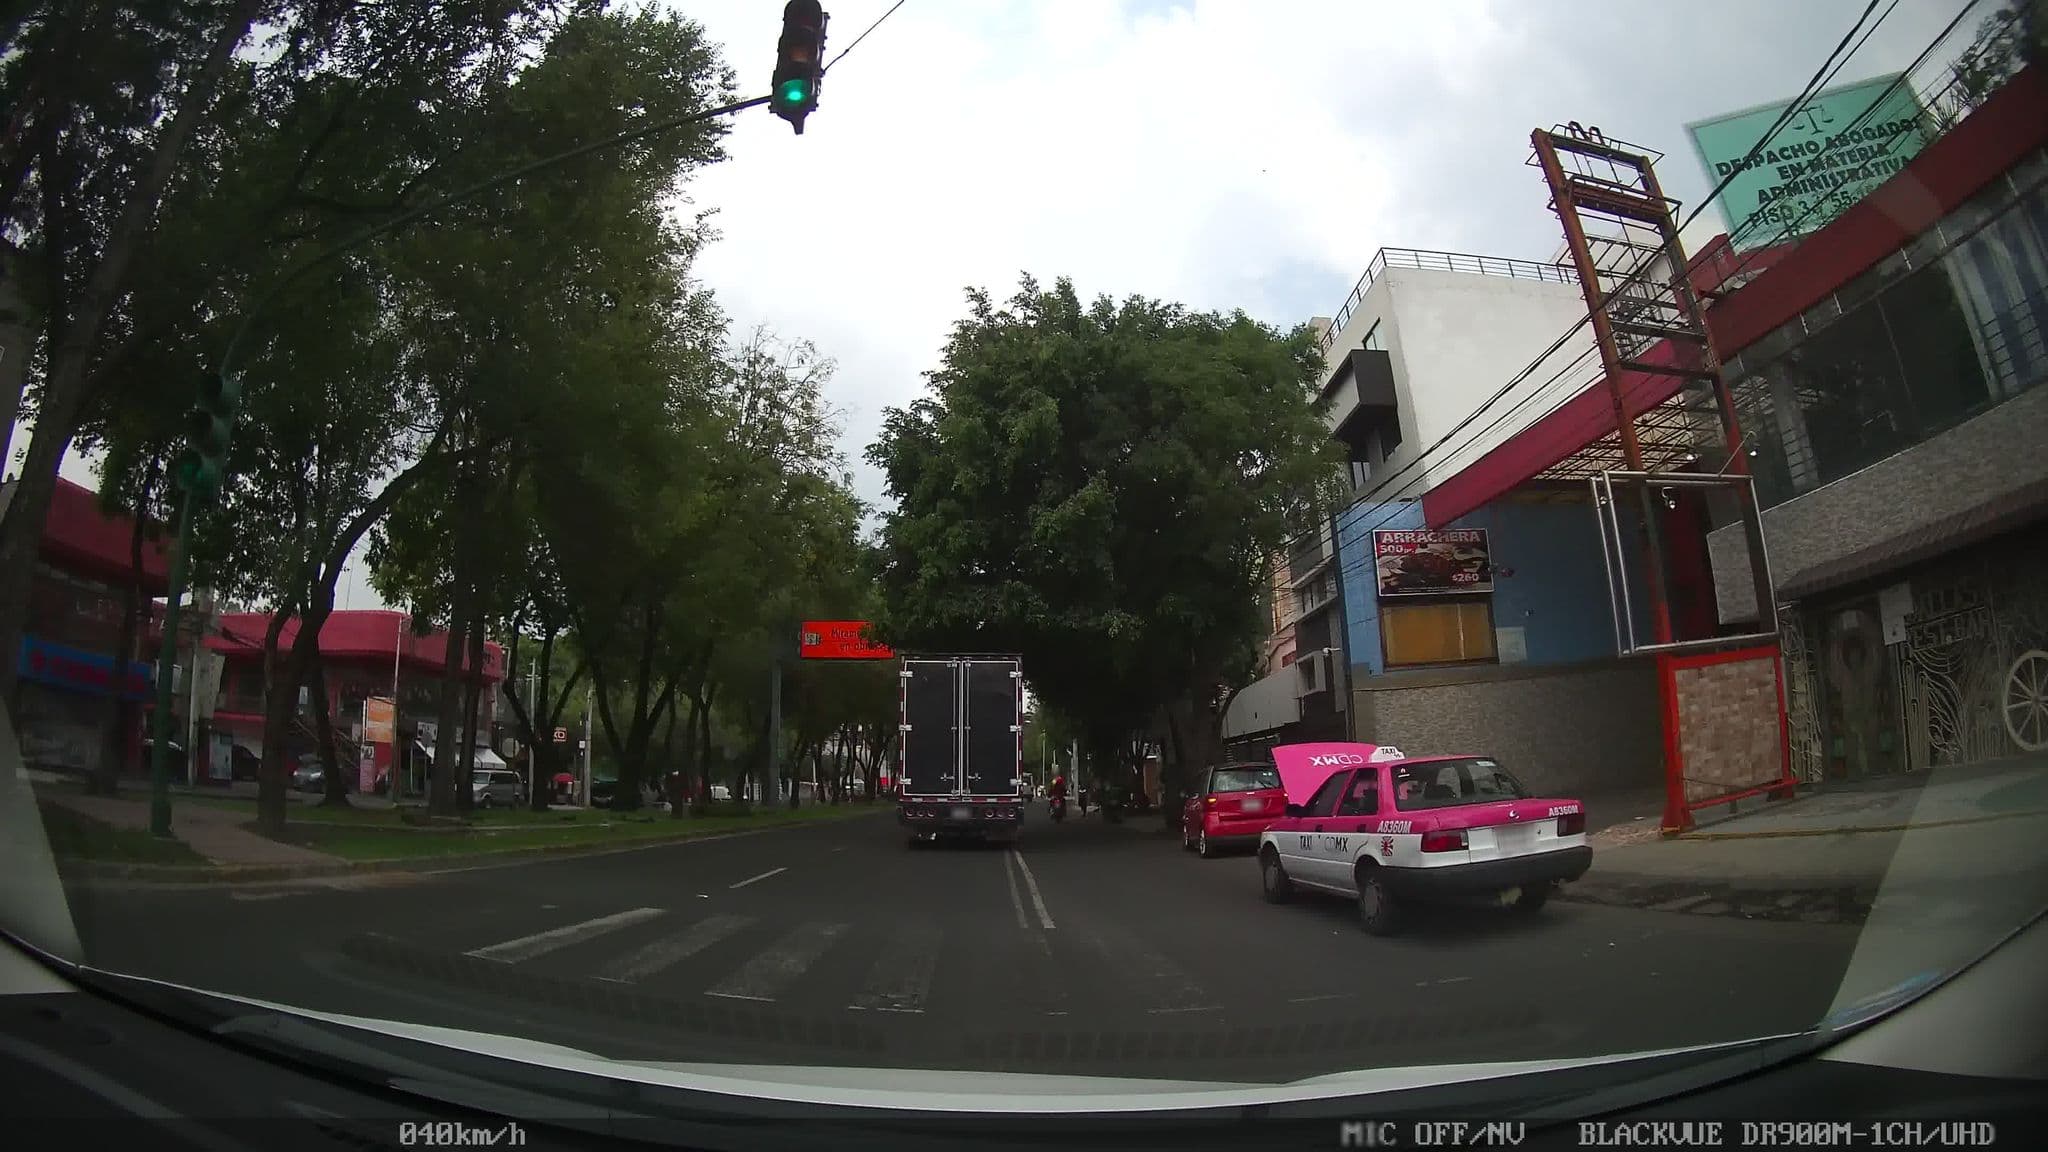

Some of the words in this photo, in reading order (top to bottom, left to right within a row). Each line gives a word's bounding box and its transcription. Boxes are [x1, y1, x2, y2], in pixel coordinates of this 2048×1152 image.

[1715, 140, 1819, 176] DESPACHO
[1776, 162, 1805, 180] EN
[1807, 143, 1889, 170] MATERIA
[1382, 531, 1480, 544] ARRACHERA
[1377, 820, 1412, 834] A8360M
[1300, 835, 1313, 851] TAXI
[1325, 836, 1349, 852] CDMX
